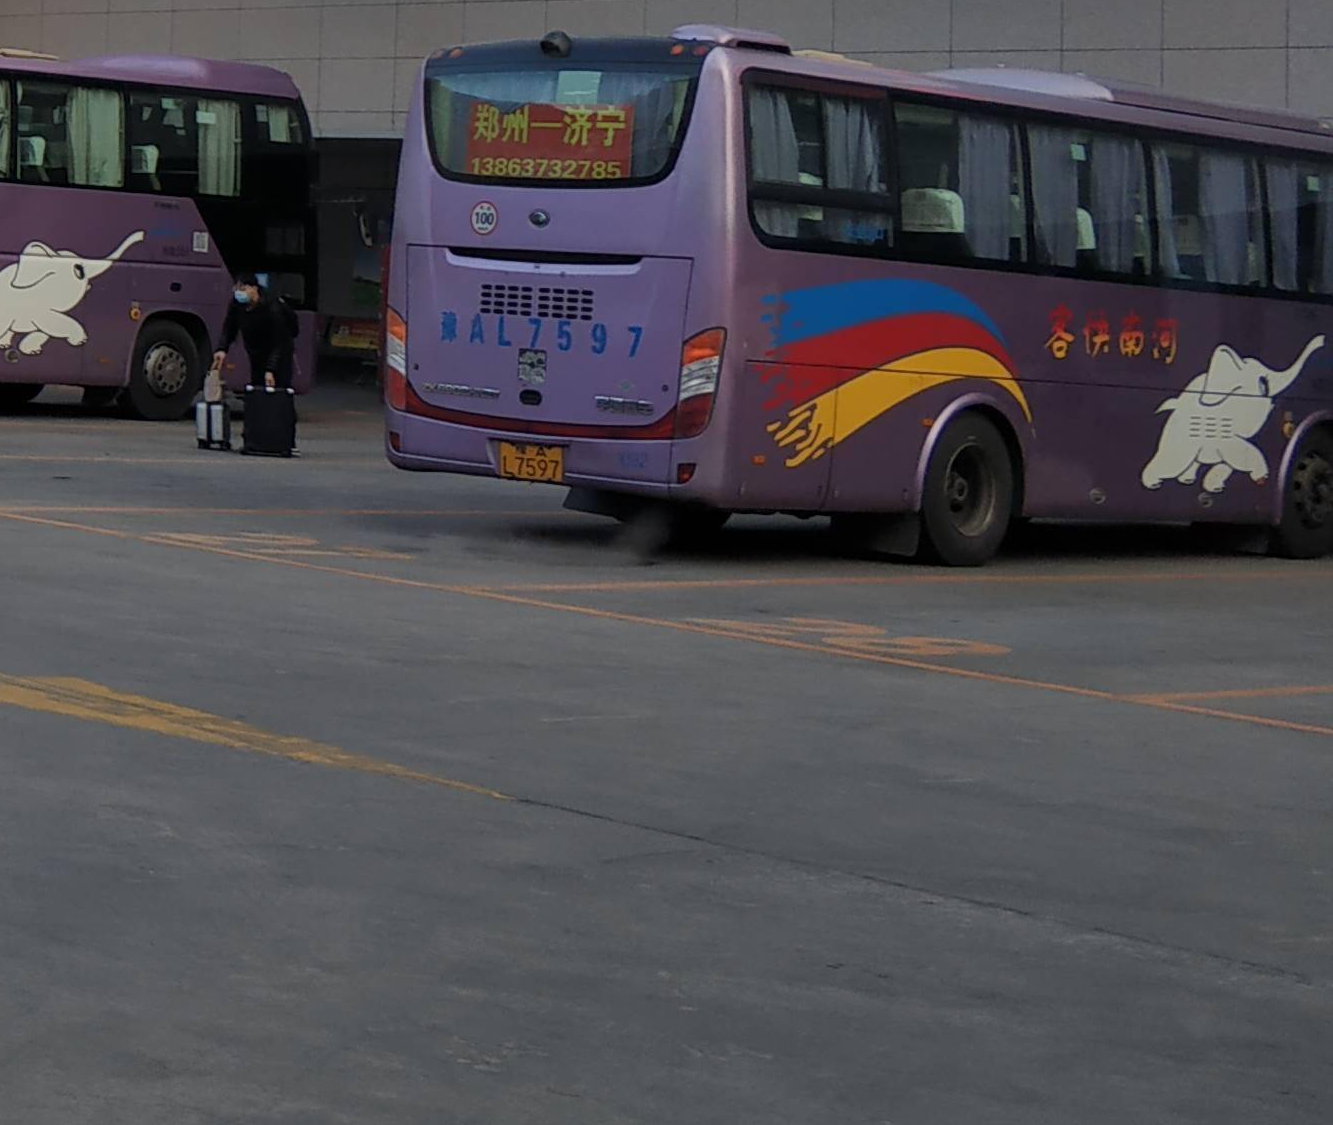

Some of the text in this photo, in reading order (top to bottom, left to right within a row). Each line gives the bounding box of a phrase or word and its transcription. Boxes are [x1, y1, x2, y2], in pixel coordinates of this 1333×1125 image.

[471, 156, 622, 180] 13863732785
[475, 211, 495, 226] 100
[503, 455, 560, 478] L7597
